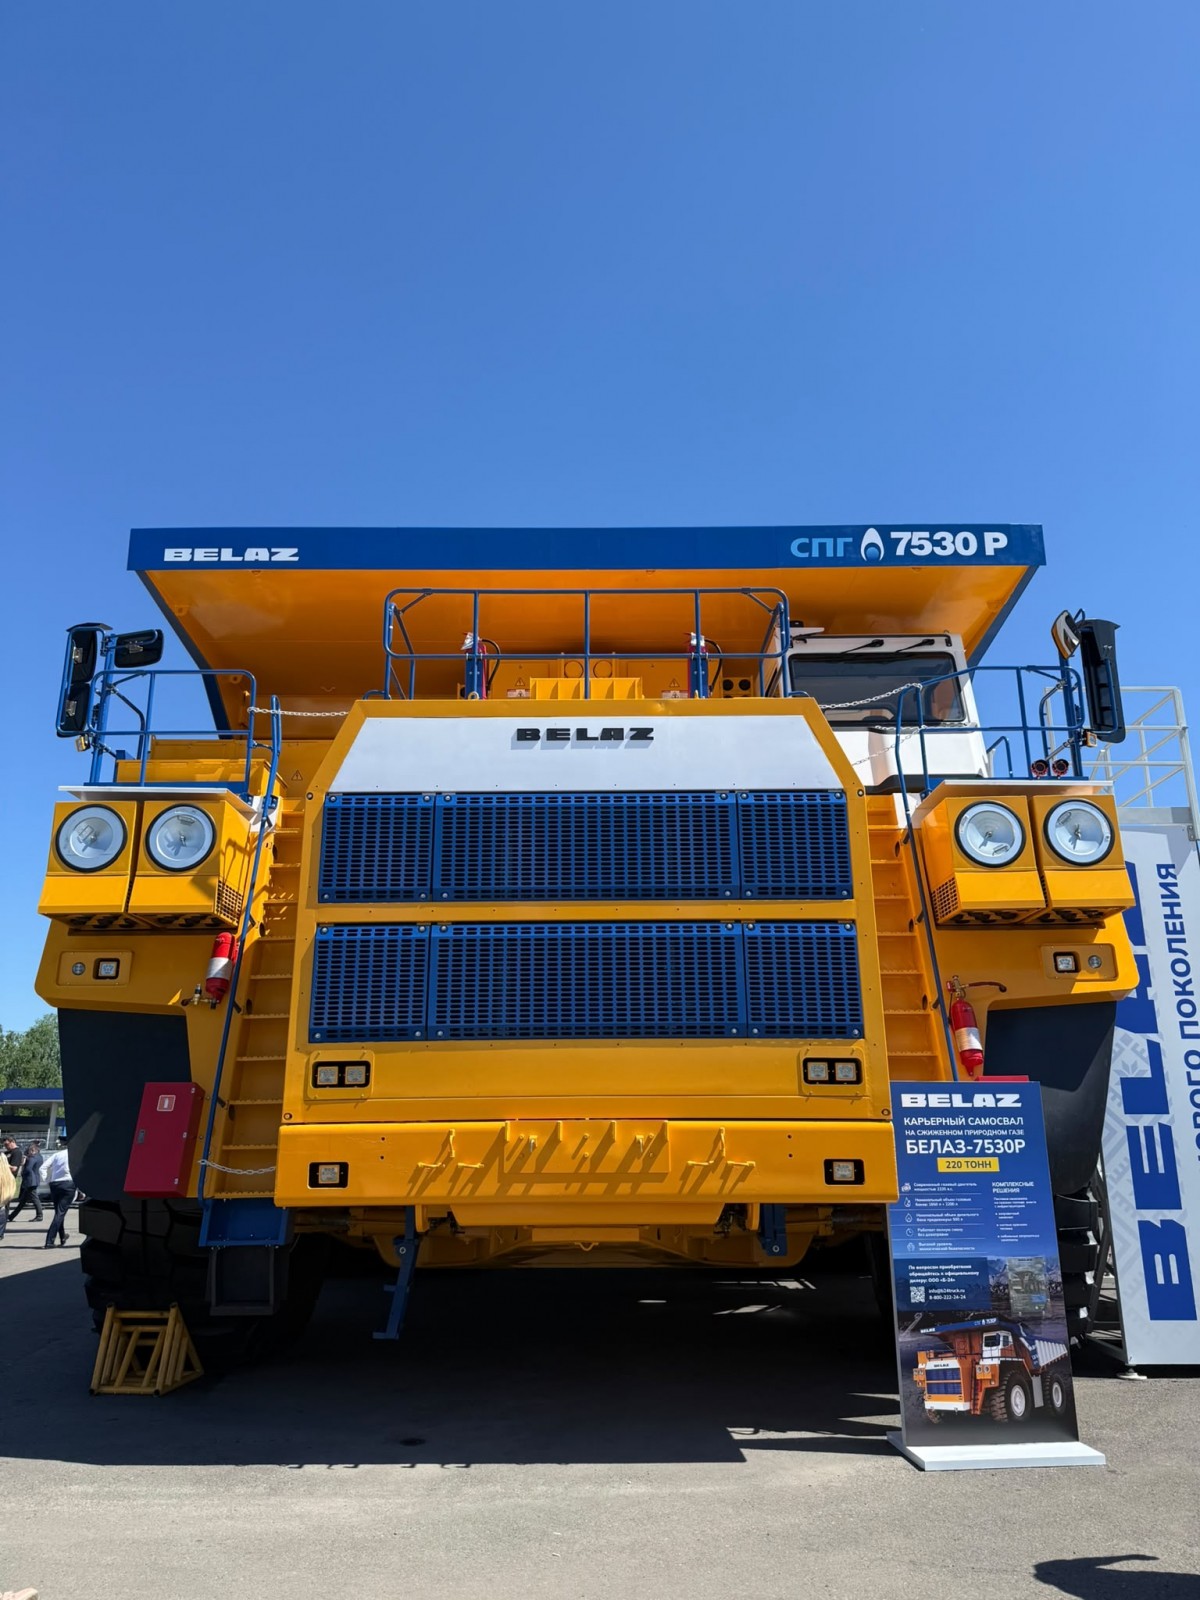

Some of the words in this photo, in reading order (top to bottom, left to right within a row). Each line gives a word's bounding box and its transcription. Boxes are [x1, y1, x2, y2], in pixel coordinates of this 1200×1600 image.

[790, 538, 853, 557] СПГ
[890, 531, 978, 556] 7530
[984, 532, 1008, 556] Р
[164, 548, 299, 561] BELAZ
[517, 728, 654, 741] BELAZ
[1156, 863, 1200, 1039] ПОКОЛЕНИЯ
[901, 1094, 1022, 1107] BELAZ
[904, 1115, 966, 1126] КАРЬЕРНЫЙ
[968, 1117, 1024, 1126] САМОСВАЛ
[964, 1129, 1008, 1137] ПРИРОДНОМ
[906, 1139, 1026, 1154] БЕЛАЗ-7530Р
[946, 1161, 962, 1169] 220
[965, 1161, 992, 1169] ТОНН
